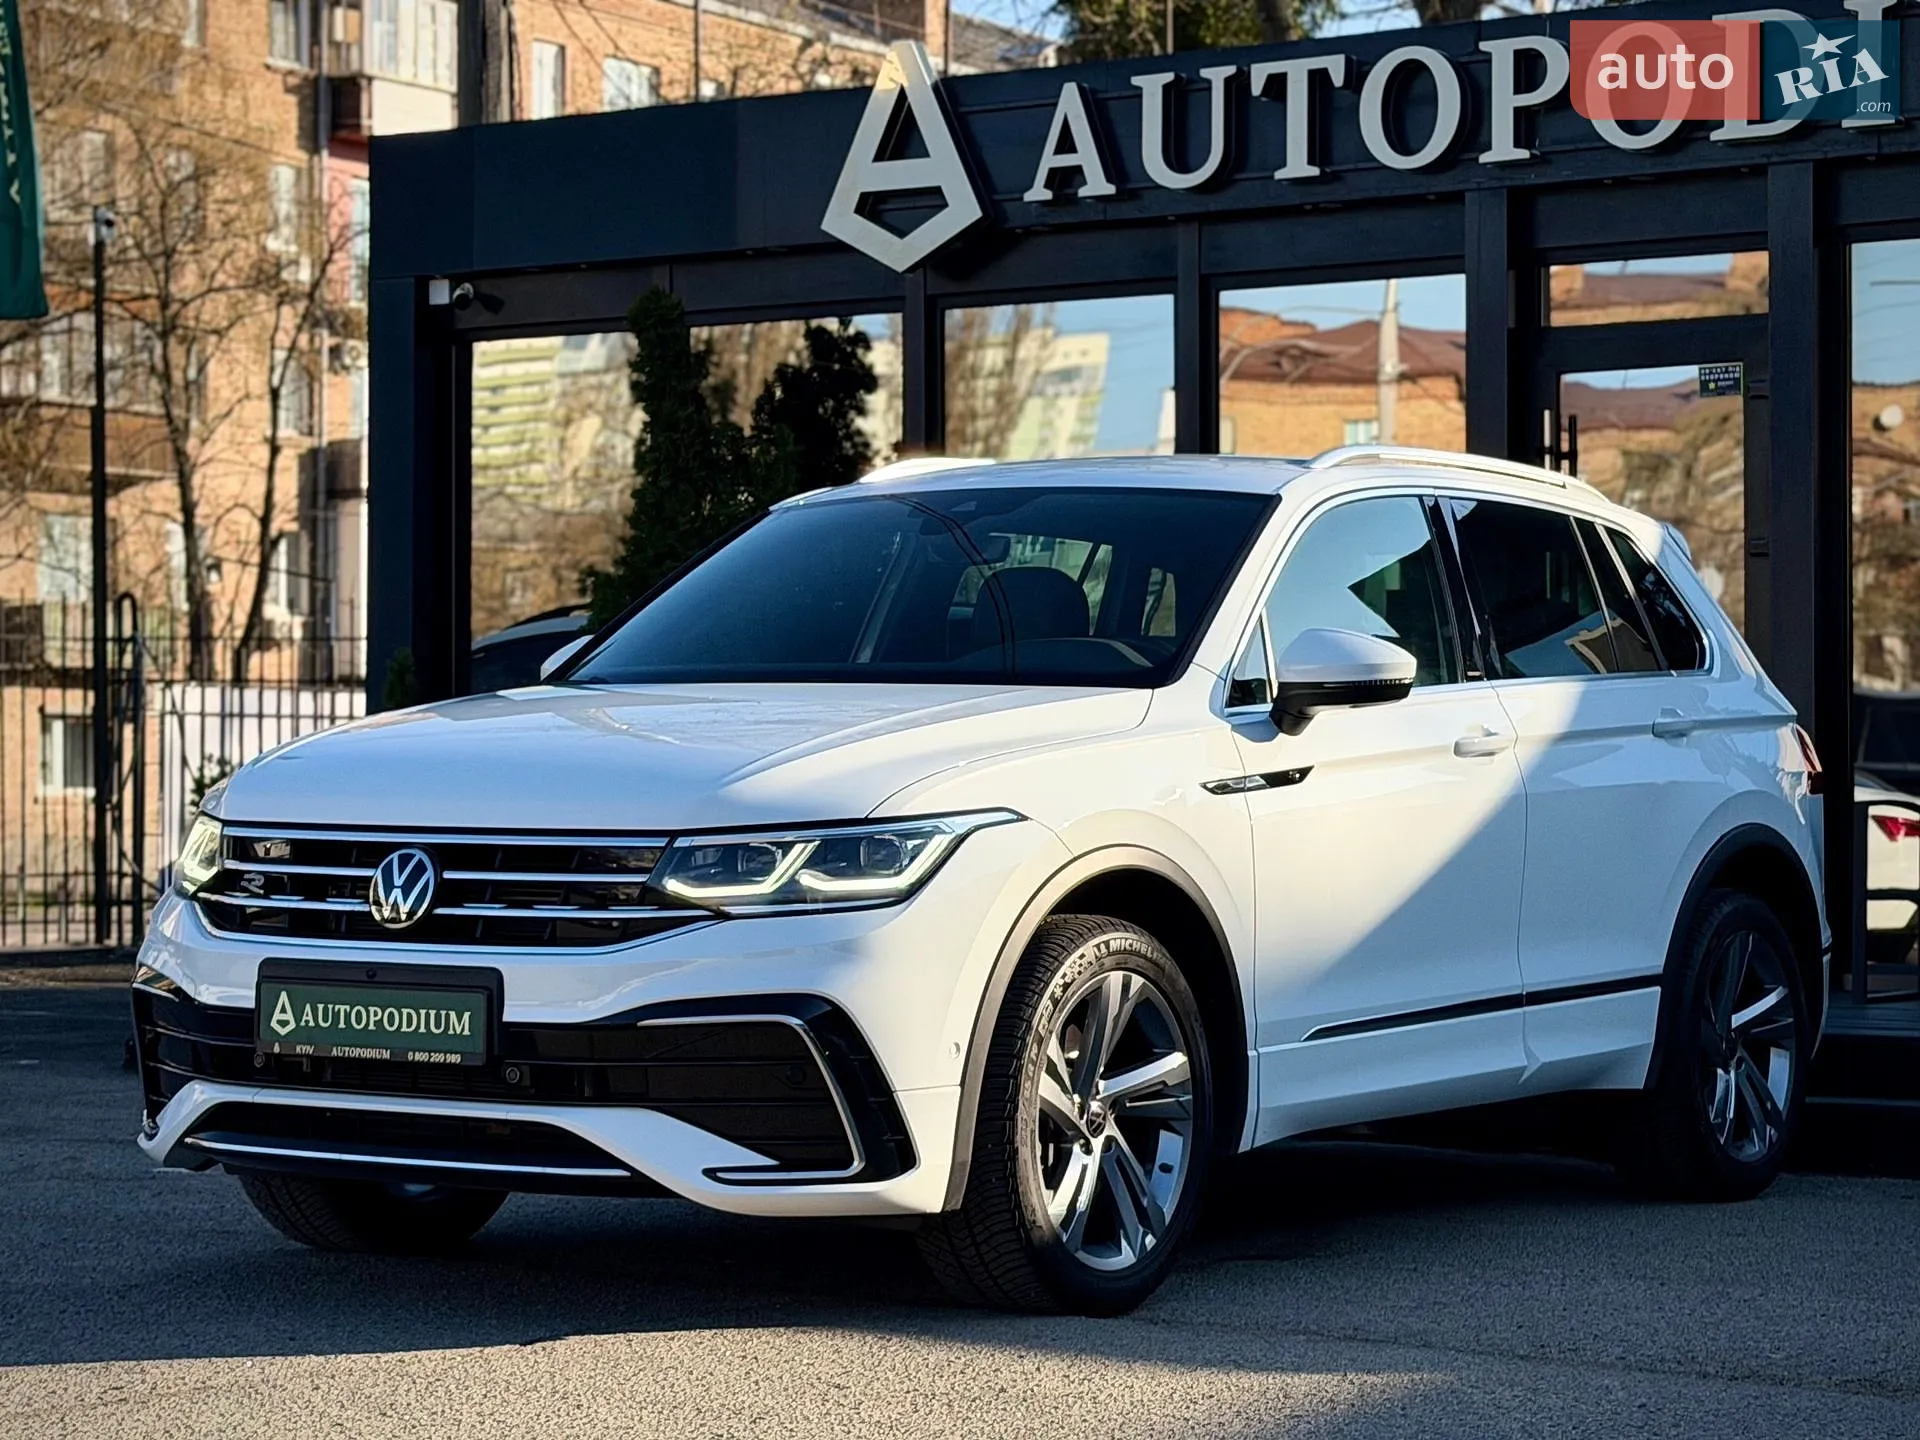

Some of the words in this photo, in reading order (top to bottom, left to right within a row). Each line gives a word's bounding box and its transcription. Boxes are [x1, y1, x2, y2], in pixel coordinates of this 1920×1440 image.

[300, 1003, 472, 1036] AUTOPODIUM
[295, 1045, 314, 1055] KYIV
[331, 1047, 391, 1061] AUTOPODIUM
